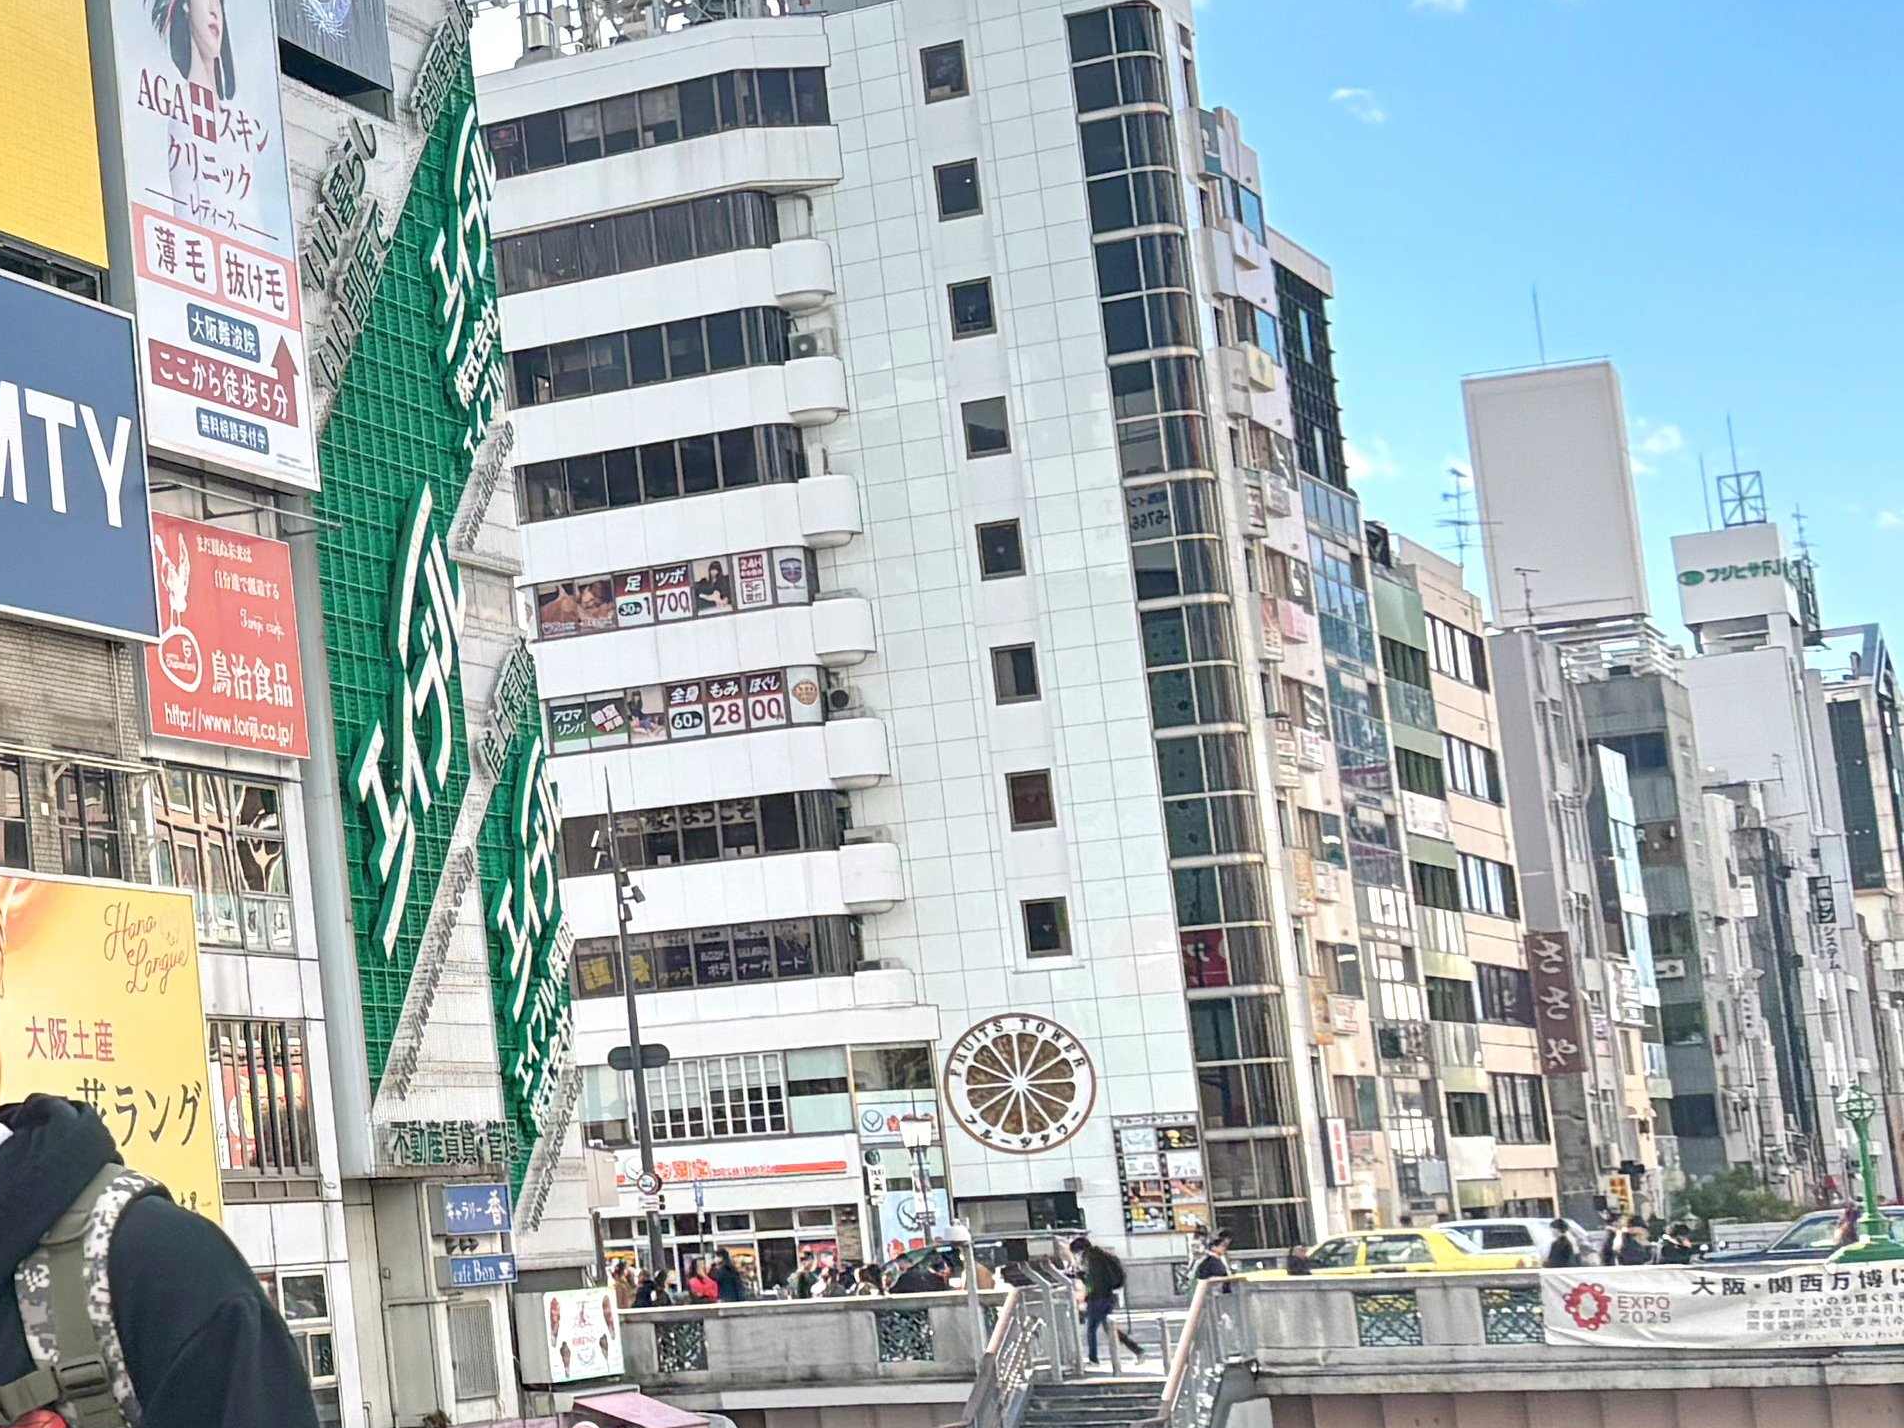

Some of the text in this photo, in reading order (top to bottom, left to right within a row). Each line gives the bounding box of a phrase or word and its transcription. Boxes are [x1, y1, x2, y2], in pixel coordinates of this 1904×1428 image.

[137, 68, 270, 154] AGA スキン
[167, 133, 252, 201] クリニック
[189, 193, 239, 232] レディース
[153, 225, 207, 286] 薄毛
[225, 249, 286, 314] 抜け毛
[210, 649, 295, 709] 鳥治食品
[553, 709, 583, 723] アロマ
[103, 901, 158, 961] Hana
[24, 1014, 116, 1064] 大阪土産
[1019, 1017, 1086, 1069] TOWER
[473, 1259, 497, 1283] Bon
[1617, 1295, 1672, 1310] EXPO
[1618, 1310, 1673, 1325] 2025
